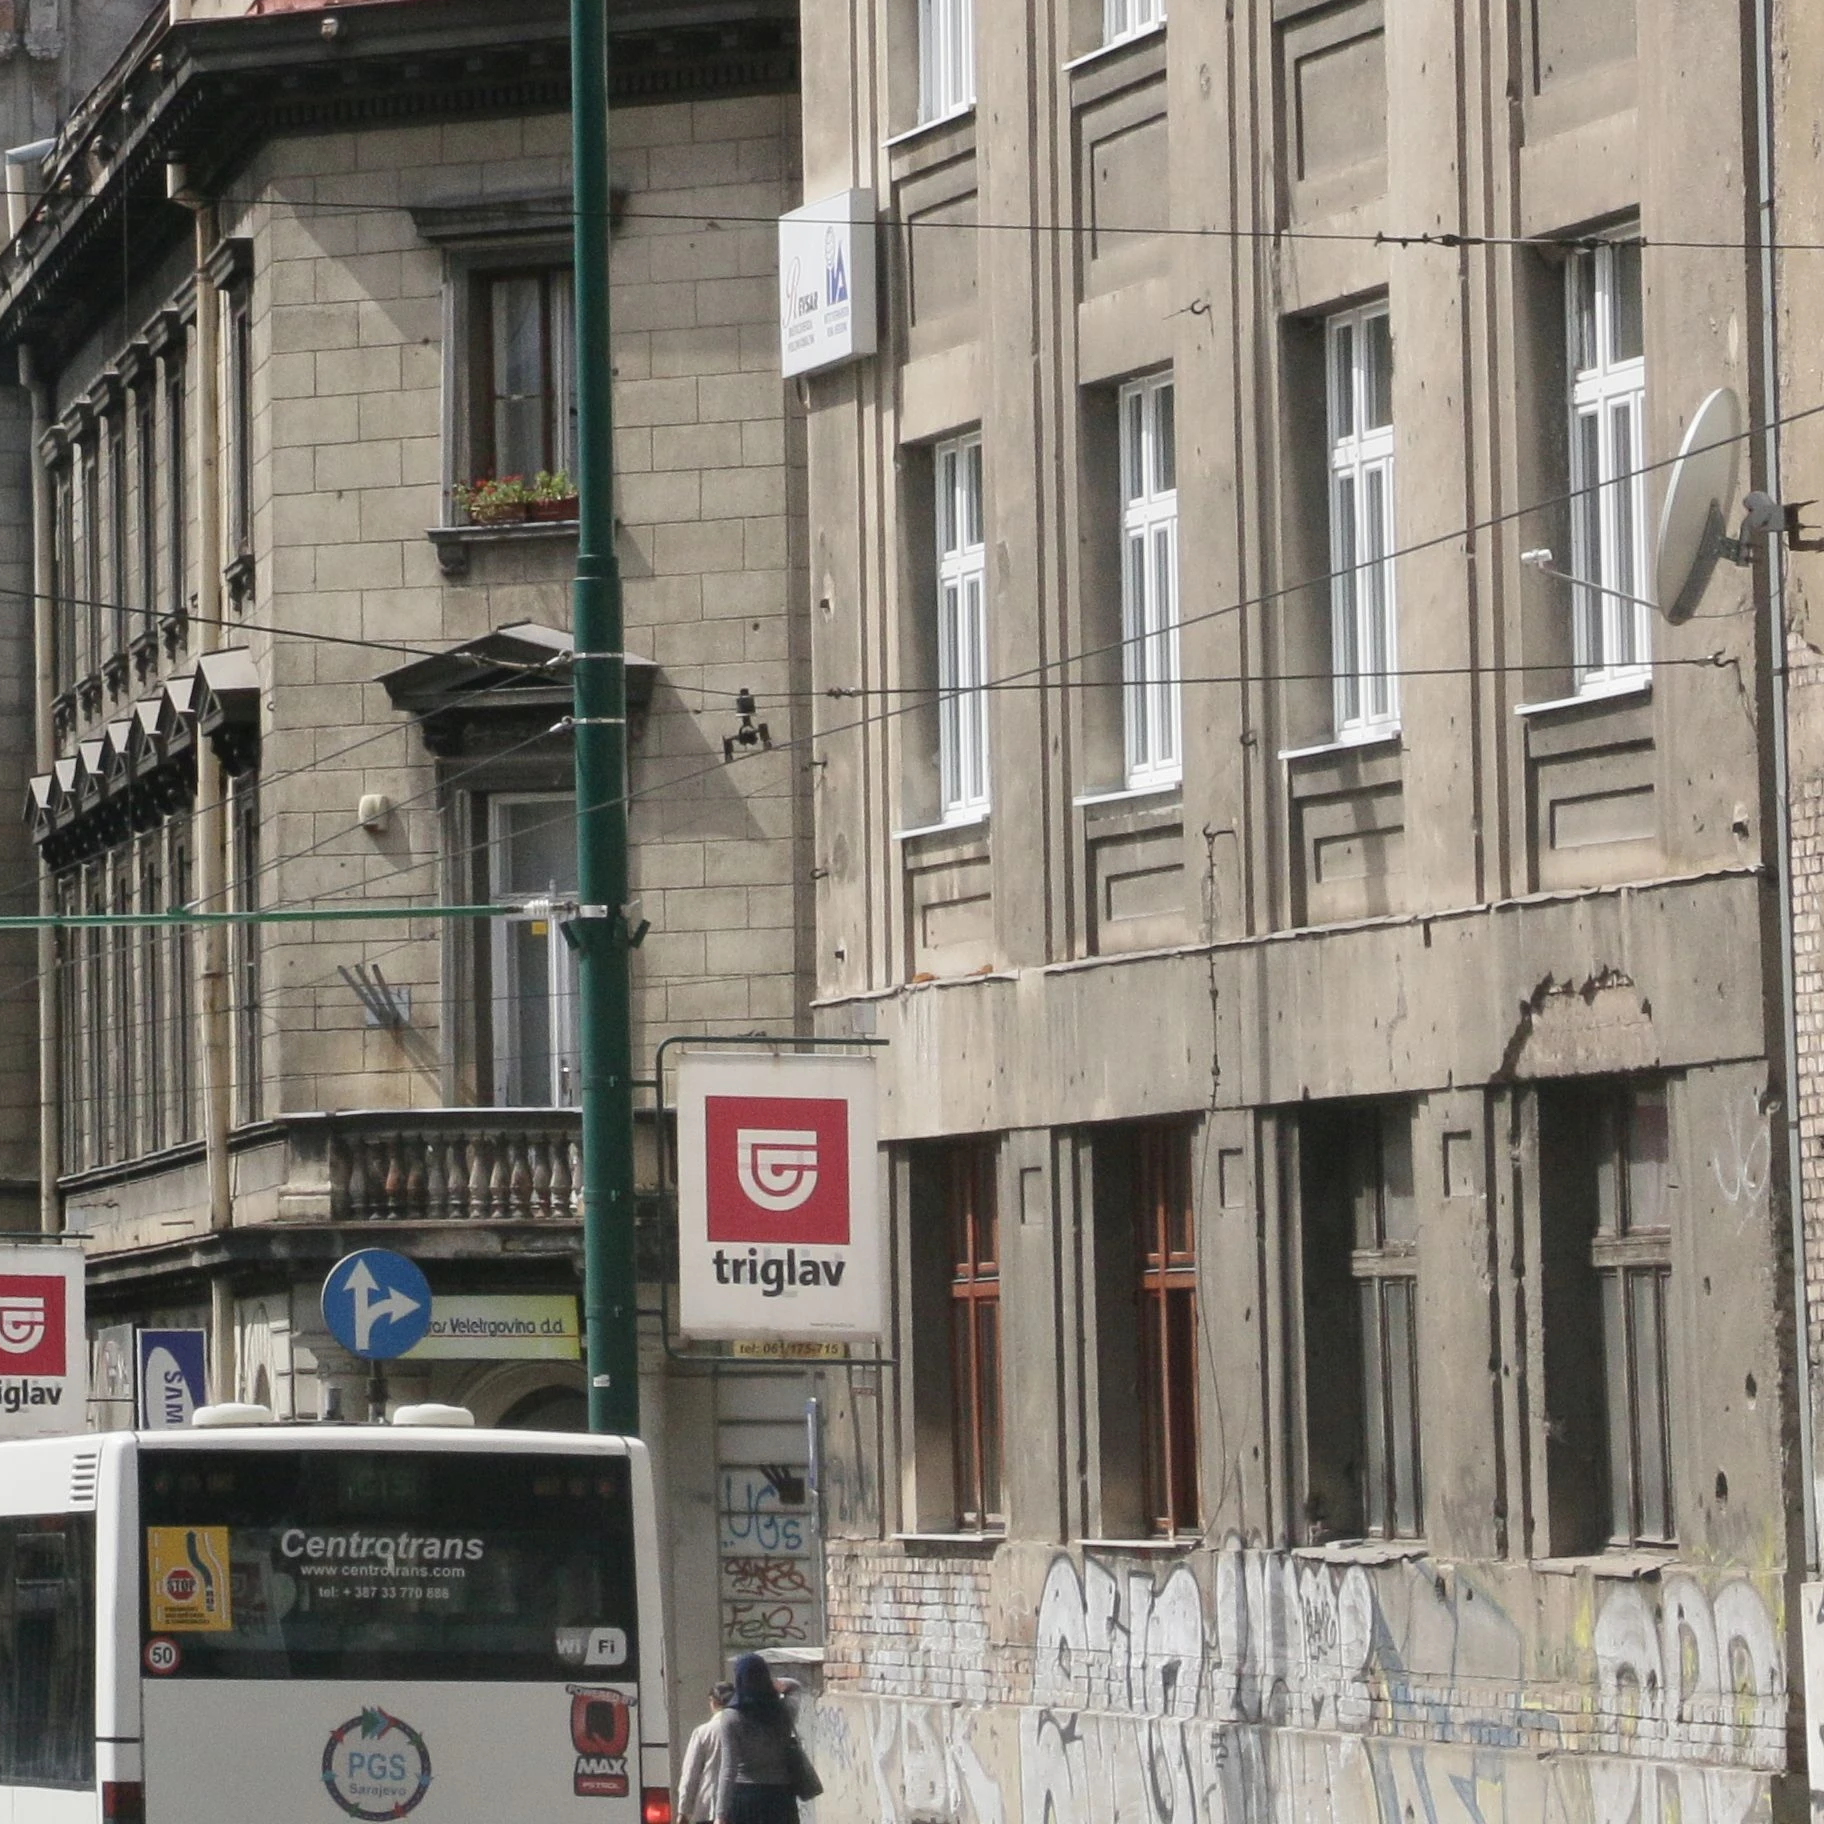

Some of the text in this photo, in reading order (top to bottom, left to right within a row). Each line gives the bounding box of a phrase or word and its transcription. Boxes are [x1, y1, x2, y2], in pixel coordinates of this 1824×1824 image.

[712, 1247, 846, 1298] triglav
[450, 1317, 536, 1338] Veletrgovina
[739, 1343, 760, 1354] tel:
[164, 1370, 184, 1425] SAM
[280, 1528, 485, 1561] Centrotrans
[167, 1578, 197, 1593] STOP
[318, 1585, 339, 1599] tel:
[355, 1586, 377, 1599] 387
[381, 1587, 397, 1599] 33
[400, 1586, 423, 1599] 770
[152, 1646, 173, 1665] 50
[348, 1752, 407, 1781] PGS
[577, 1757, 626, 1775] MAX
[350, 1782, 407, 1797] Sarajevo
